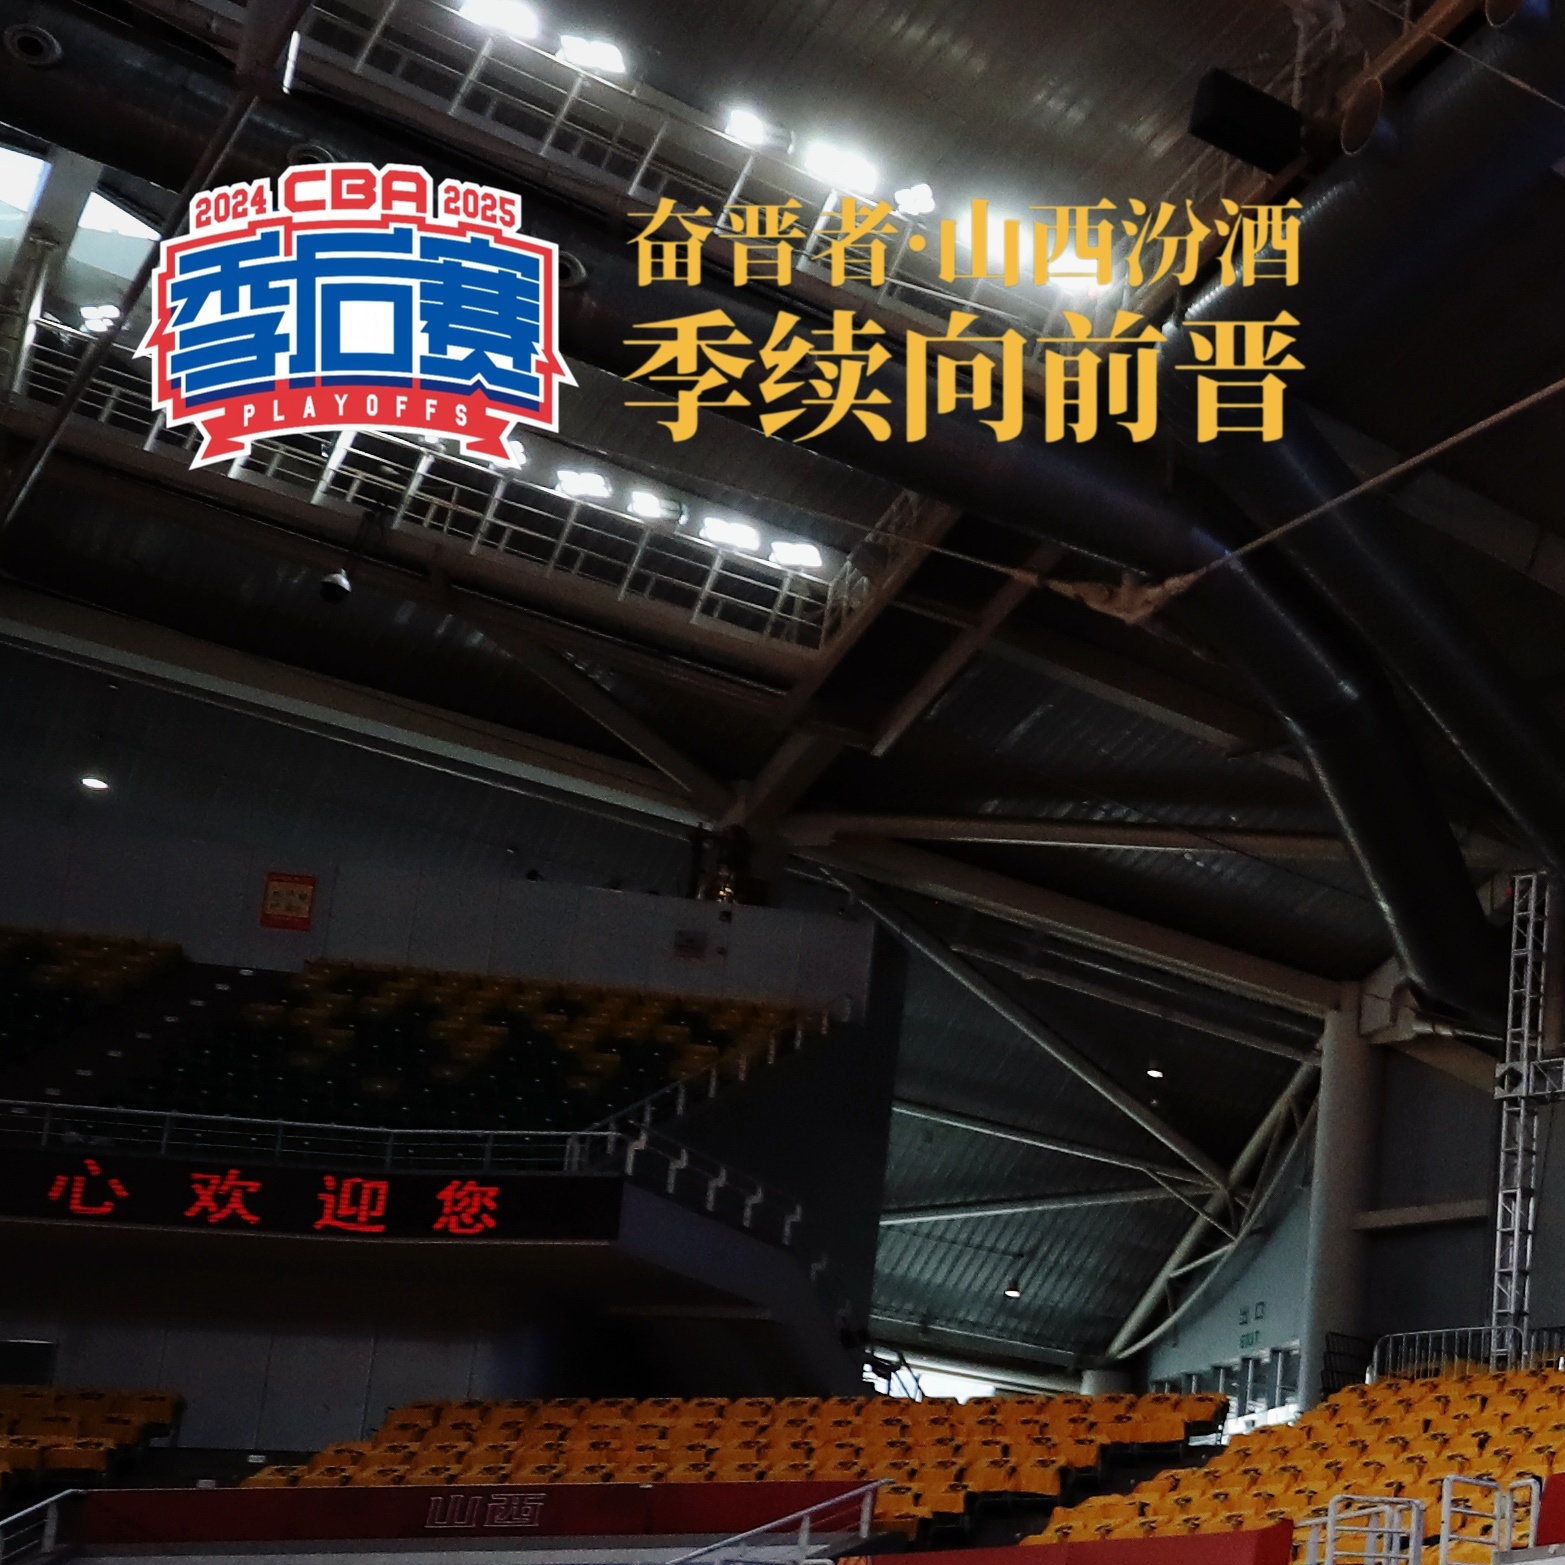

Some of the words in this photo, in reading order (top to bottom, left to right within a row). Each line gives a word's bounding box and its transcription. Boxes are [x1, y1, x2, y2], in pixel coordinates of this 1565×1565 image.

[48, 1159, 500, 1234] 心欢迎您
[425, 1493, 546, 1528] 山西
